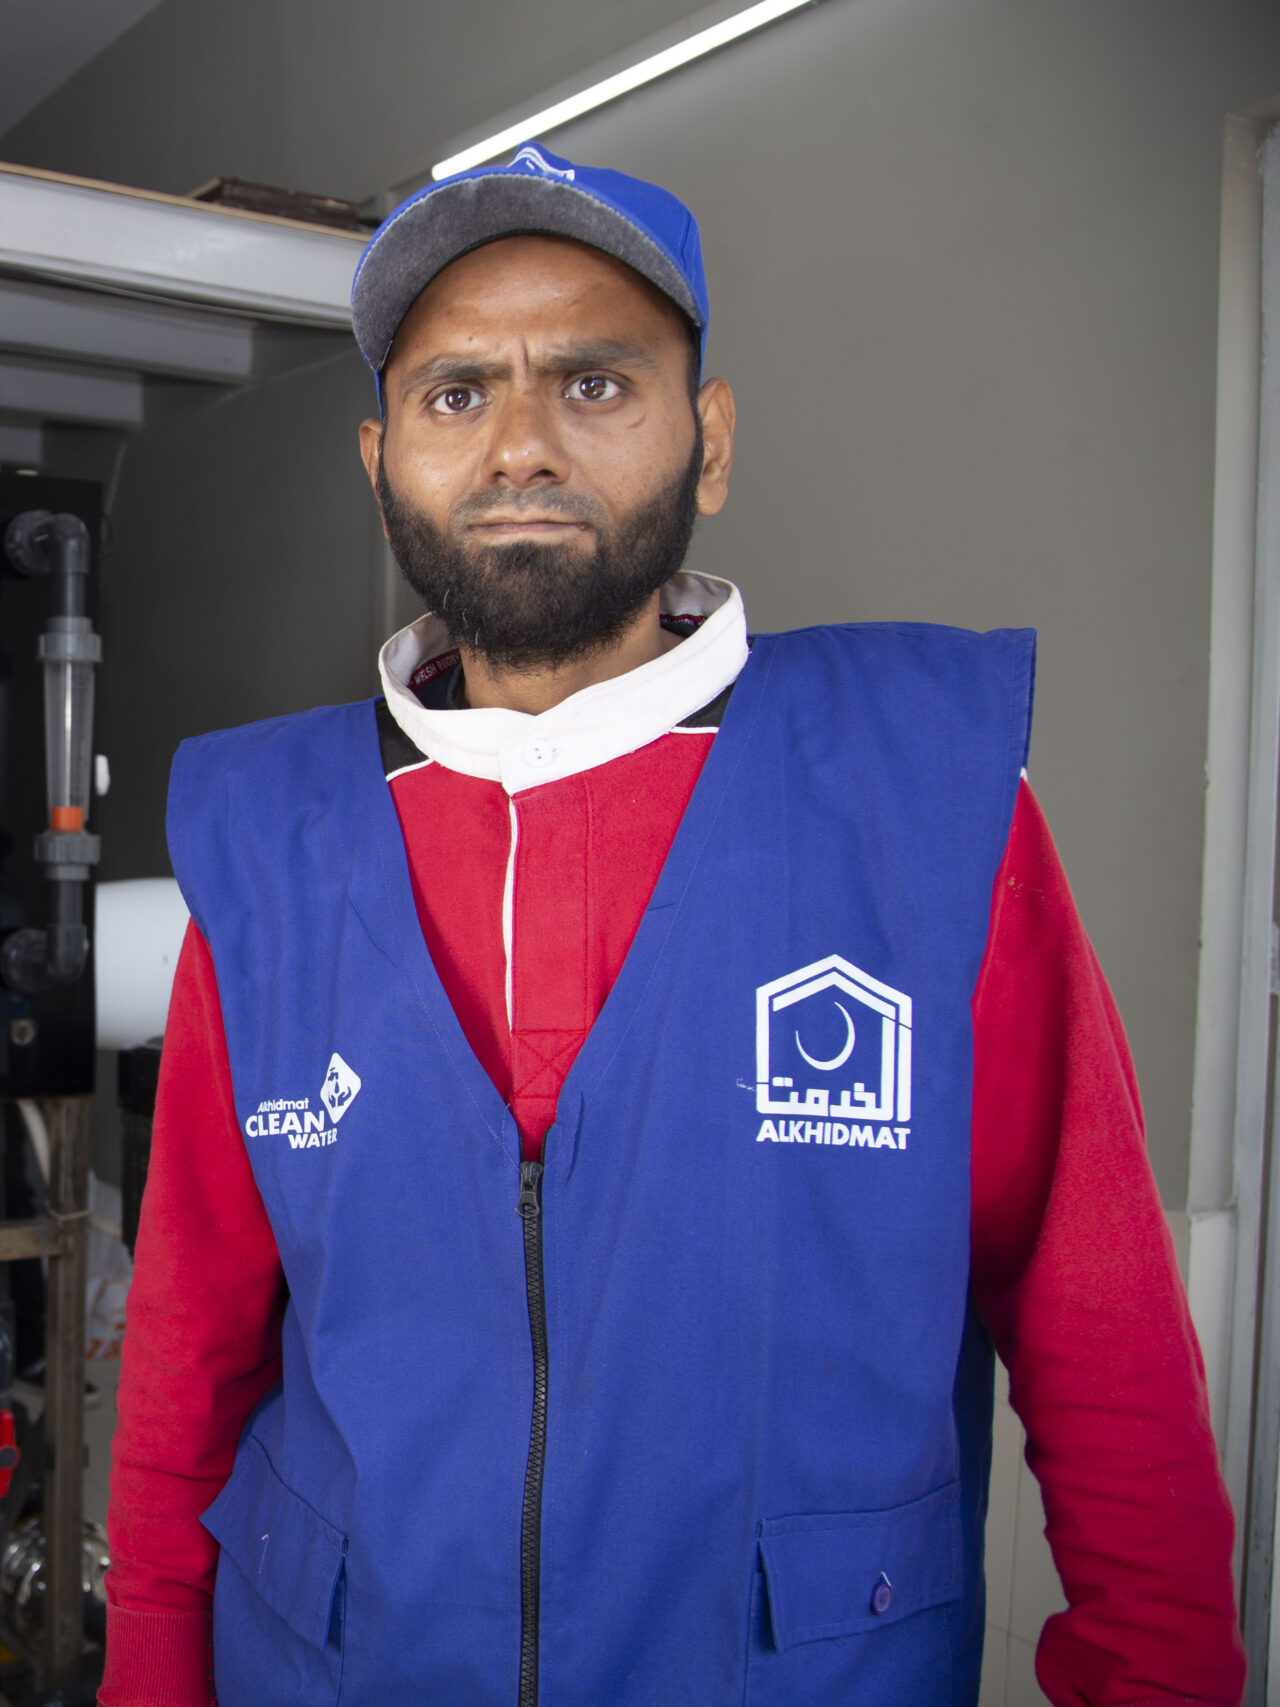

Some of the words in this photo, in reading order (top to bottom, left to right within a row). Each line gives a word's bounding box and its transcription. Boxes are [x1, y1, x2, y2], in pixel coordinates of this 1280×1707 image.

[257, 1097, 309, 1113] Alkhidmat
[245, 1110, 325, 1138] CLEAN
[755, 1119, 911, 1150] ALKHIDMAT
[288, 1127, 338, 1150] WATER
